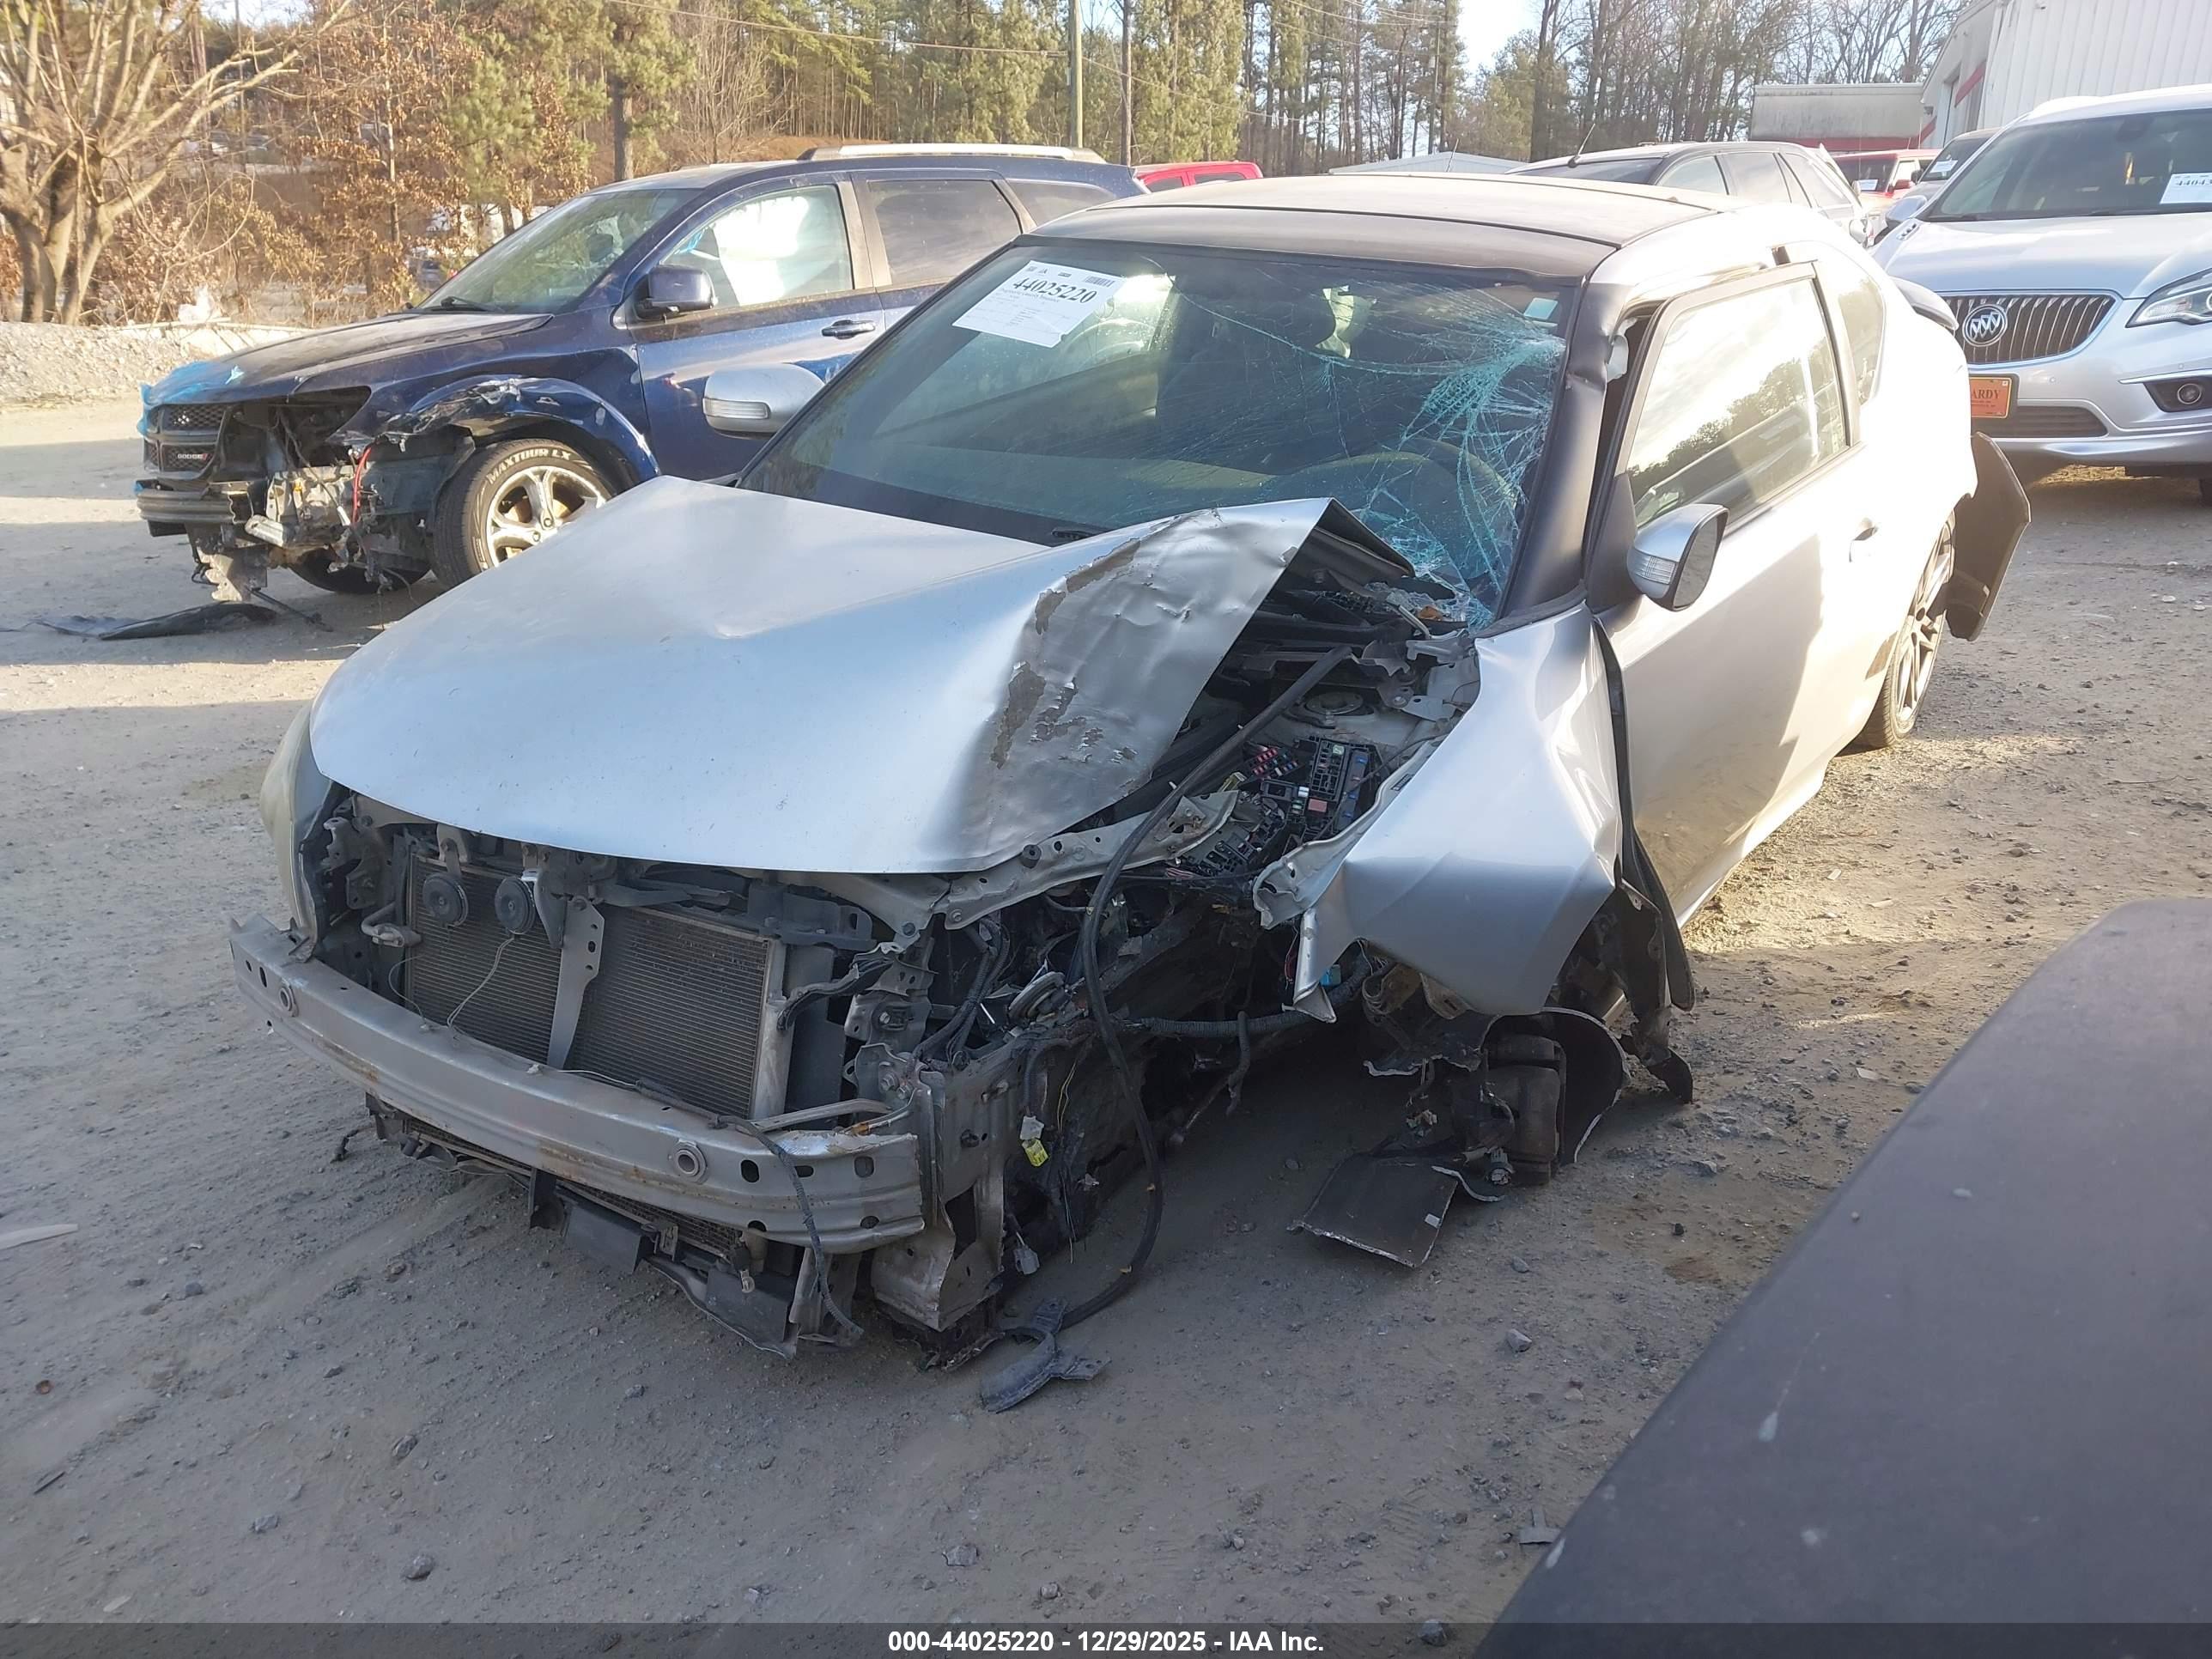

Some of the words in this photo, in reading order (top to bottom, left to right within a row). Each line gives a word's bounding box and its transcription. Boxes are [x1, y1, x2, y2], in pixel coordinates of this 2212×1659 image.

[1013, 277, 1097, 303] 44025220
[486, 448, 549, 484] MAXTOUR
[551, 449, 571, 460] LX
